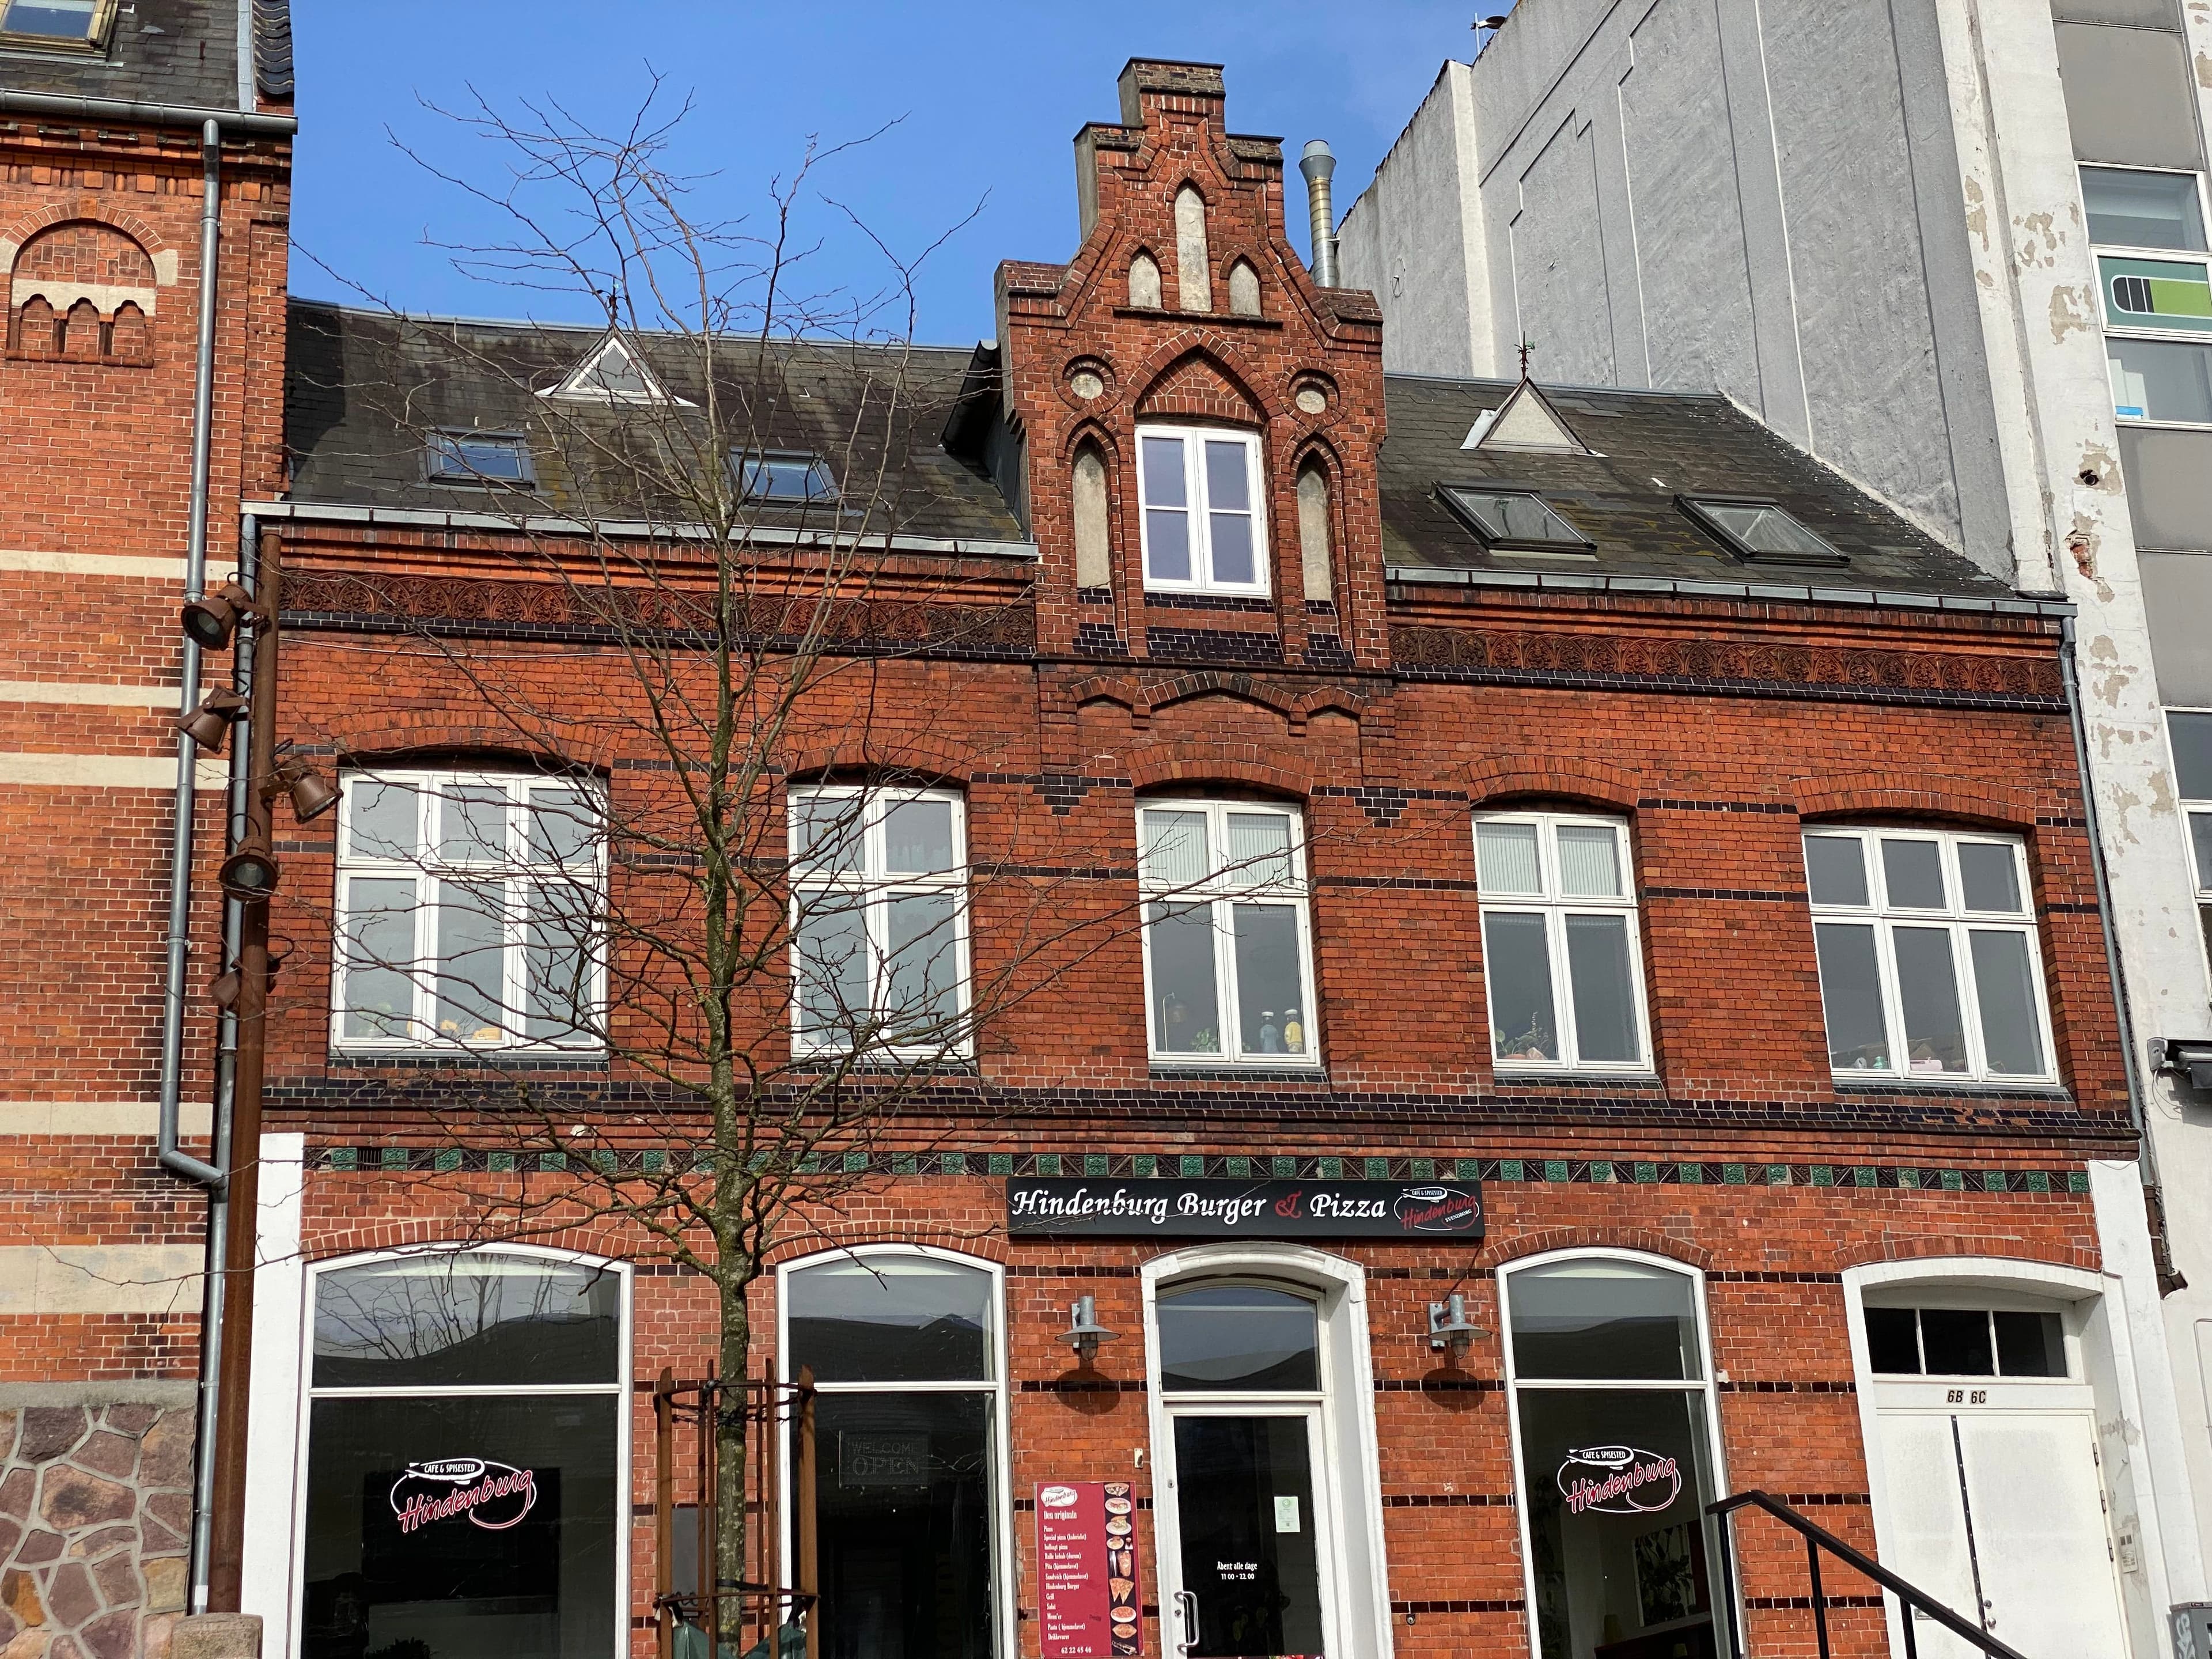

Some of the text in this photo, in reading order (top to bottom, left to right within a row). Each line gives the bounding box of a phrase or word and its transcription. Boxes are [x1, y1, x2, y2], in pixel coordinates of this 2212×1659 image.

[1012, 1188, 1387, 1225] Hindenburg Burger & Pizza
[1401, 1195, 1476, 1230] Hindenburg
[1445, 1209, 1472, 1222] SVENDBORG
[1948, 1390, 1986, 1403] 6B 6C
[1582, 1451, 1595, 1459] CAFE
[1600, 1451, 1626, 1459] SPISESTED
[424, 1464, 439, 1474] CAFE
[446, 1463, 475, 1473] SPISESTED
[853, 1456, 919, 1476] OPEN
[1566, 1457, 1677, 1514] Hindenburg
[397, 1470, 533, 1533] Hindenburg
[1217, 1561, 1257, 1571] Åbent alle dage
